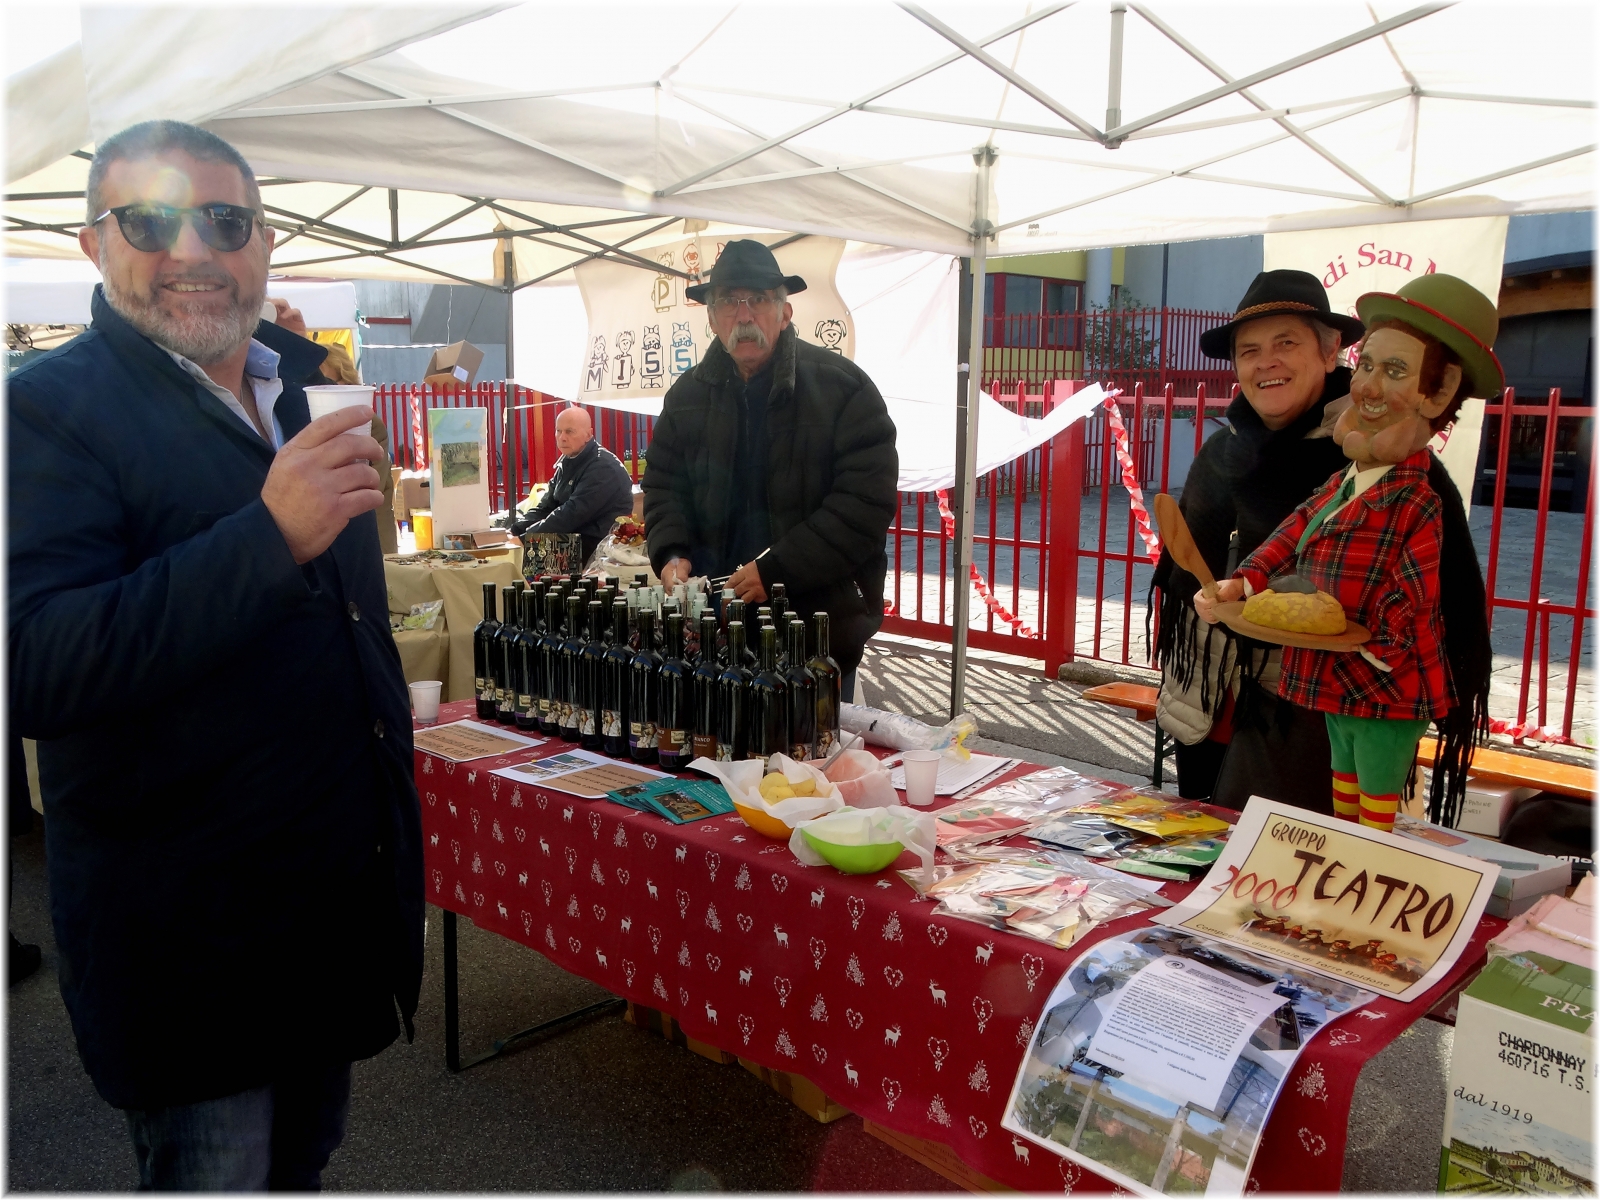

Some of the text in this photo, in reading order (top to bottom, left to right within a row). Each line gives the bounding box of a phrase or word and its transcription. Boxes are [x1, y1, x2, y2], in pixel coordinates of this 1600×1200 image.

[1322, 254, 1349, 290] di
[1357, 242, 1413, 273] San
[1271, 821, 1327, 852] GRUPPO
[1210, 864, 1297, 911] 2000
[1287, 849, 1454, 940] TEATRO
[1252, 939, 1300, 959] dialettale
[1301, 954, 1313, 963] di
[1314, 959, 1342, 973] Torre
[1345, 970, 1390, 988] Boldone
[1498, 1031, 1586, 1073] CHARDONNAY
[1498, 1049, 1550, 1079] 460716
[1558, 1068, 1590, 1094] T.S.
[1453, 1085, 1533, 1125] dal 1919
